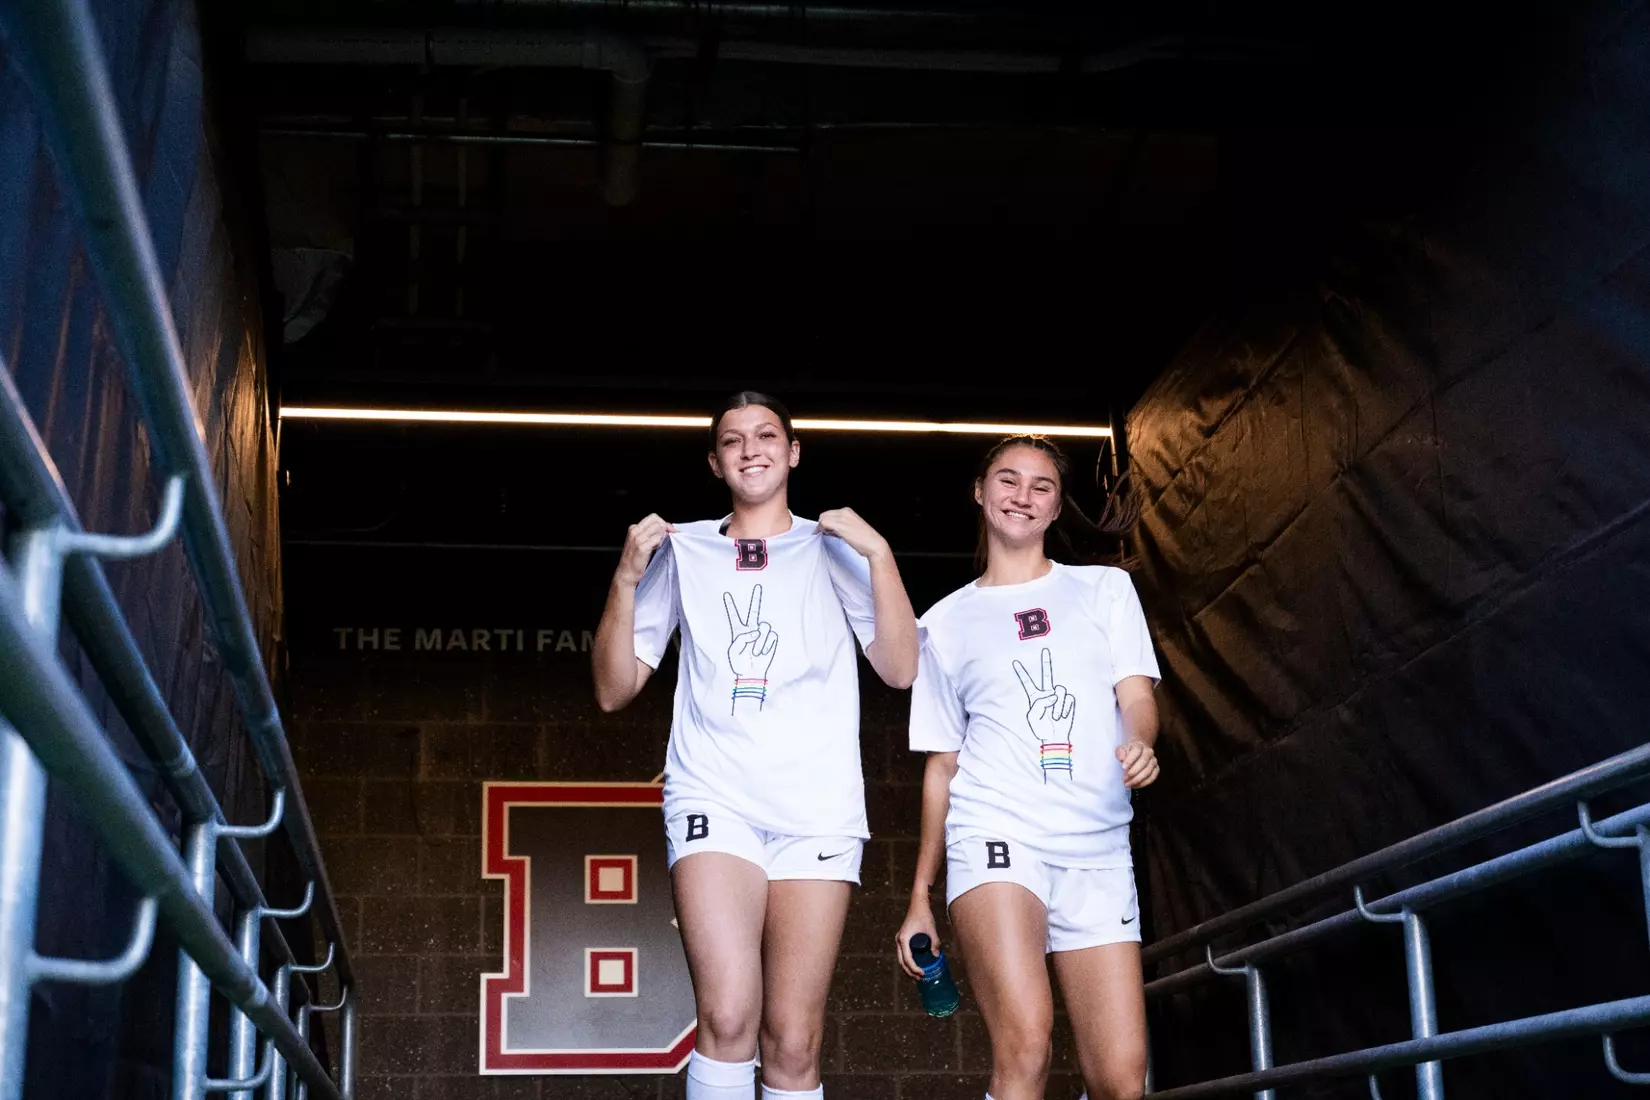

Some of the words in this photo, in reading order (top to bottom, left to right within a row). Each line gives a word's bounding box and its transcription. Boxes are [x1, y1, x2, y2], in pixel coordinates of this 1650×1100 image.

[734, 538, 768, 571] B
[332, 626, 402, 650] THE
[414, 627, 524, 652] MARTI
[1014, 608, 1051, 641] B
[686, 814, 709, 842] B
[985, 841, 1011, 869] B
[479, 781, 698, 1075] B
